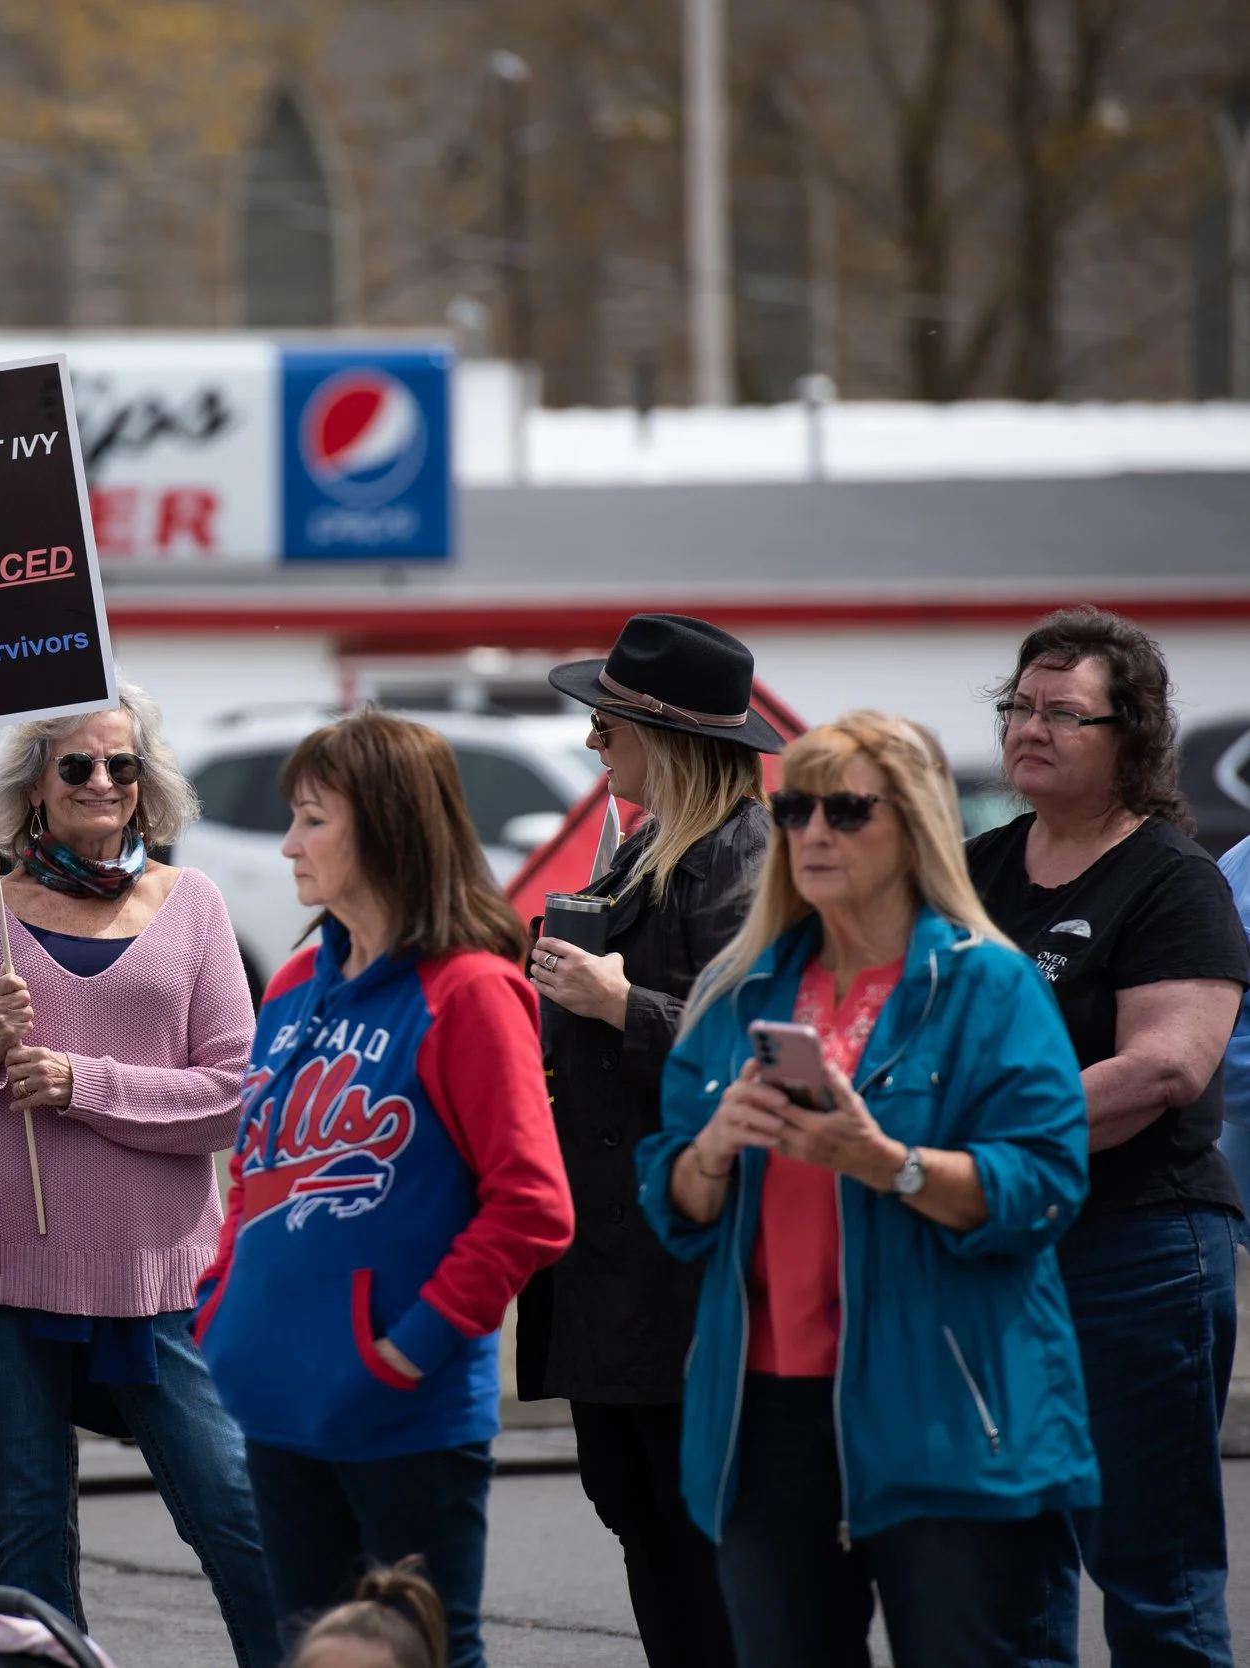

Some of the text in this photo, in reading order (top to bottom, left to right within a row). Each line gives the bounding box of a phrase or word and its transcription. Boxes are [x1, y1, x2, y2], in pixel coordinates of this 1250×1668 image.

[11, 431, 59, 461] IVY
[1036, 959, 1059, 973] THE
[1037, 951, 1068, 967] OVER
